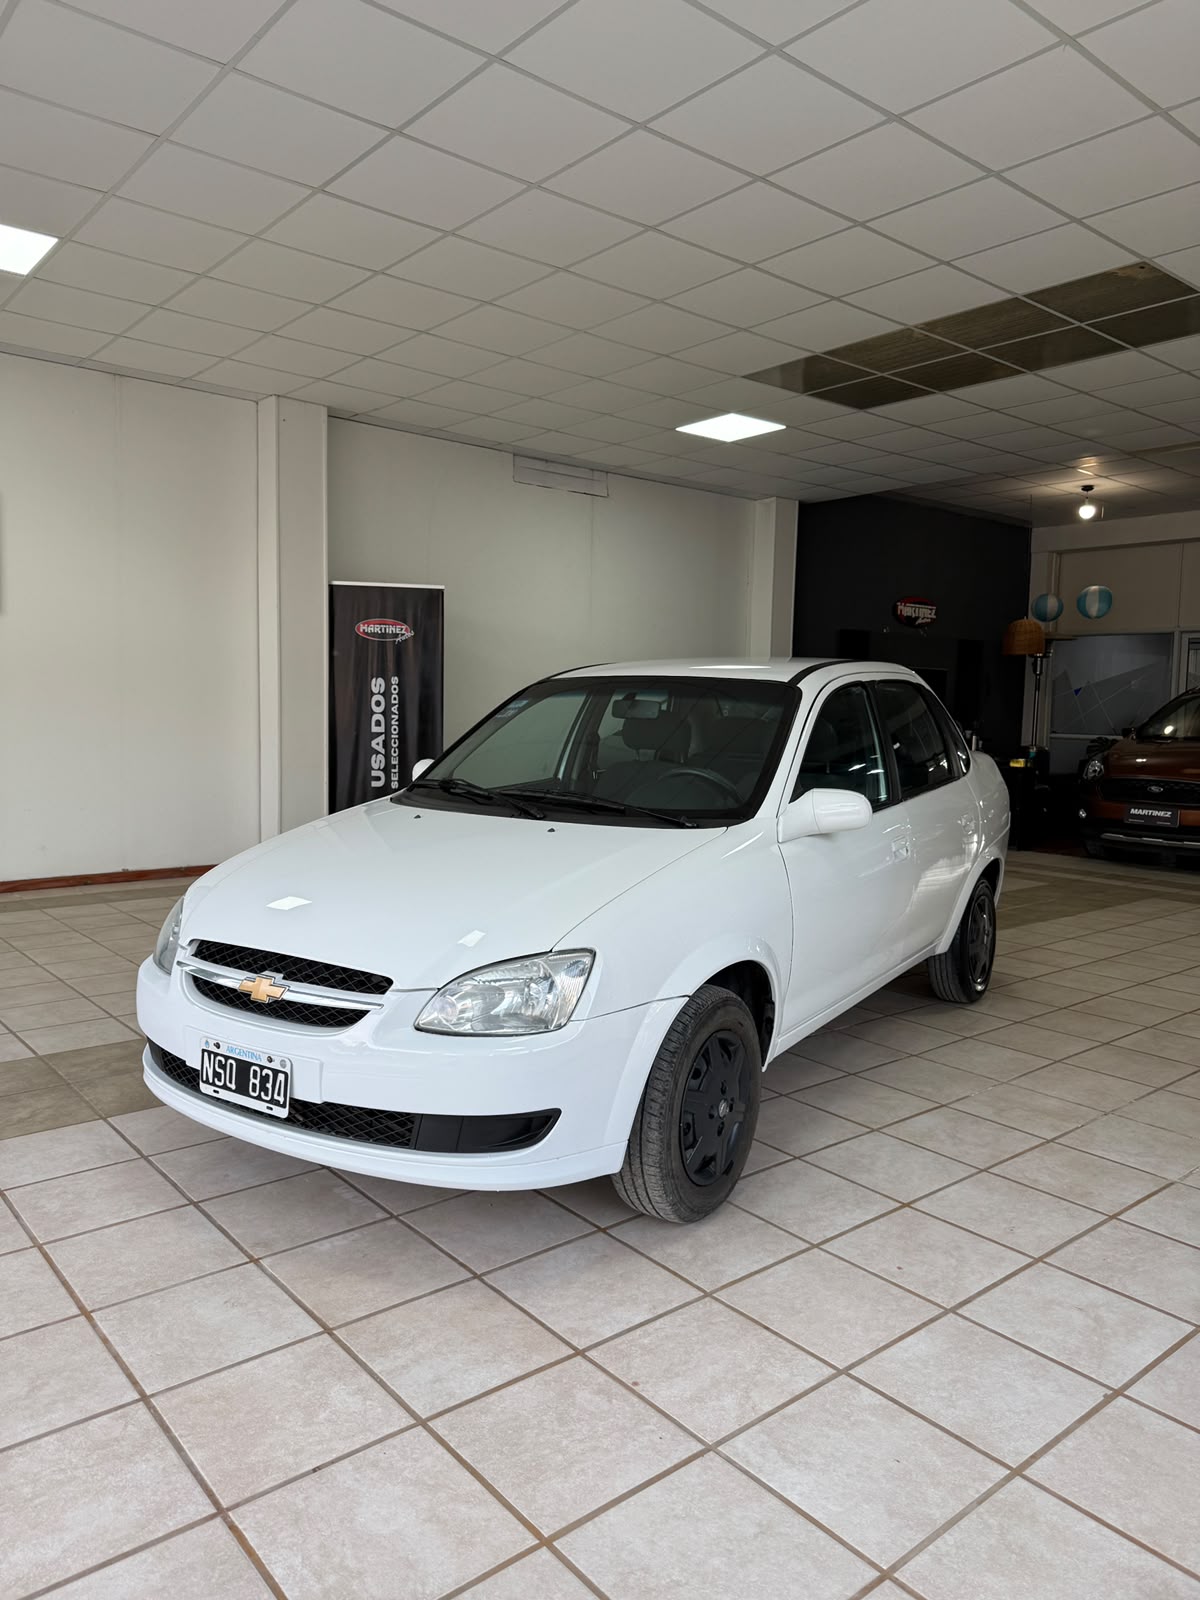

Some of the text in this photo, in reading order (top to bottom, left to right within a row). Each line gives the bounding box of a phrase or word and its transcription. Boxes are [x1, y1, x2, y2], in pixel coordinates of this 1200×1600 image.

[360, 624, 406, 634] MARTINEZ
[371, 677, 385, 787] USADOS
[391, 676, 399, 789] SELECCIONADOS
[1130, 808, 1172, 817] MARTINEZ
[226, 1045, 262, 1062] ARGENTINA
[203, 1051, 285, 1105] NSQ 834
